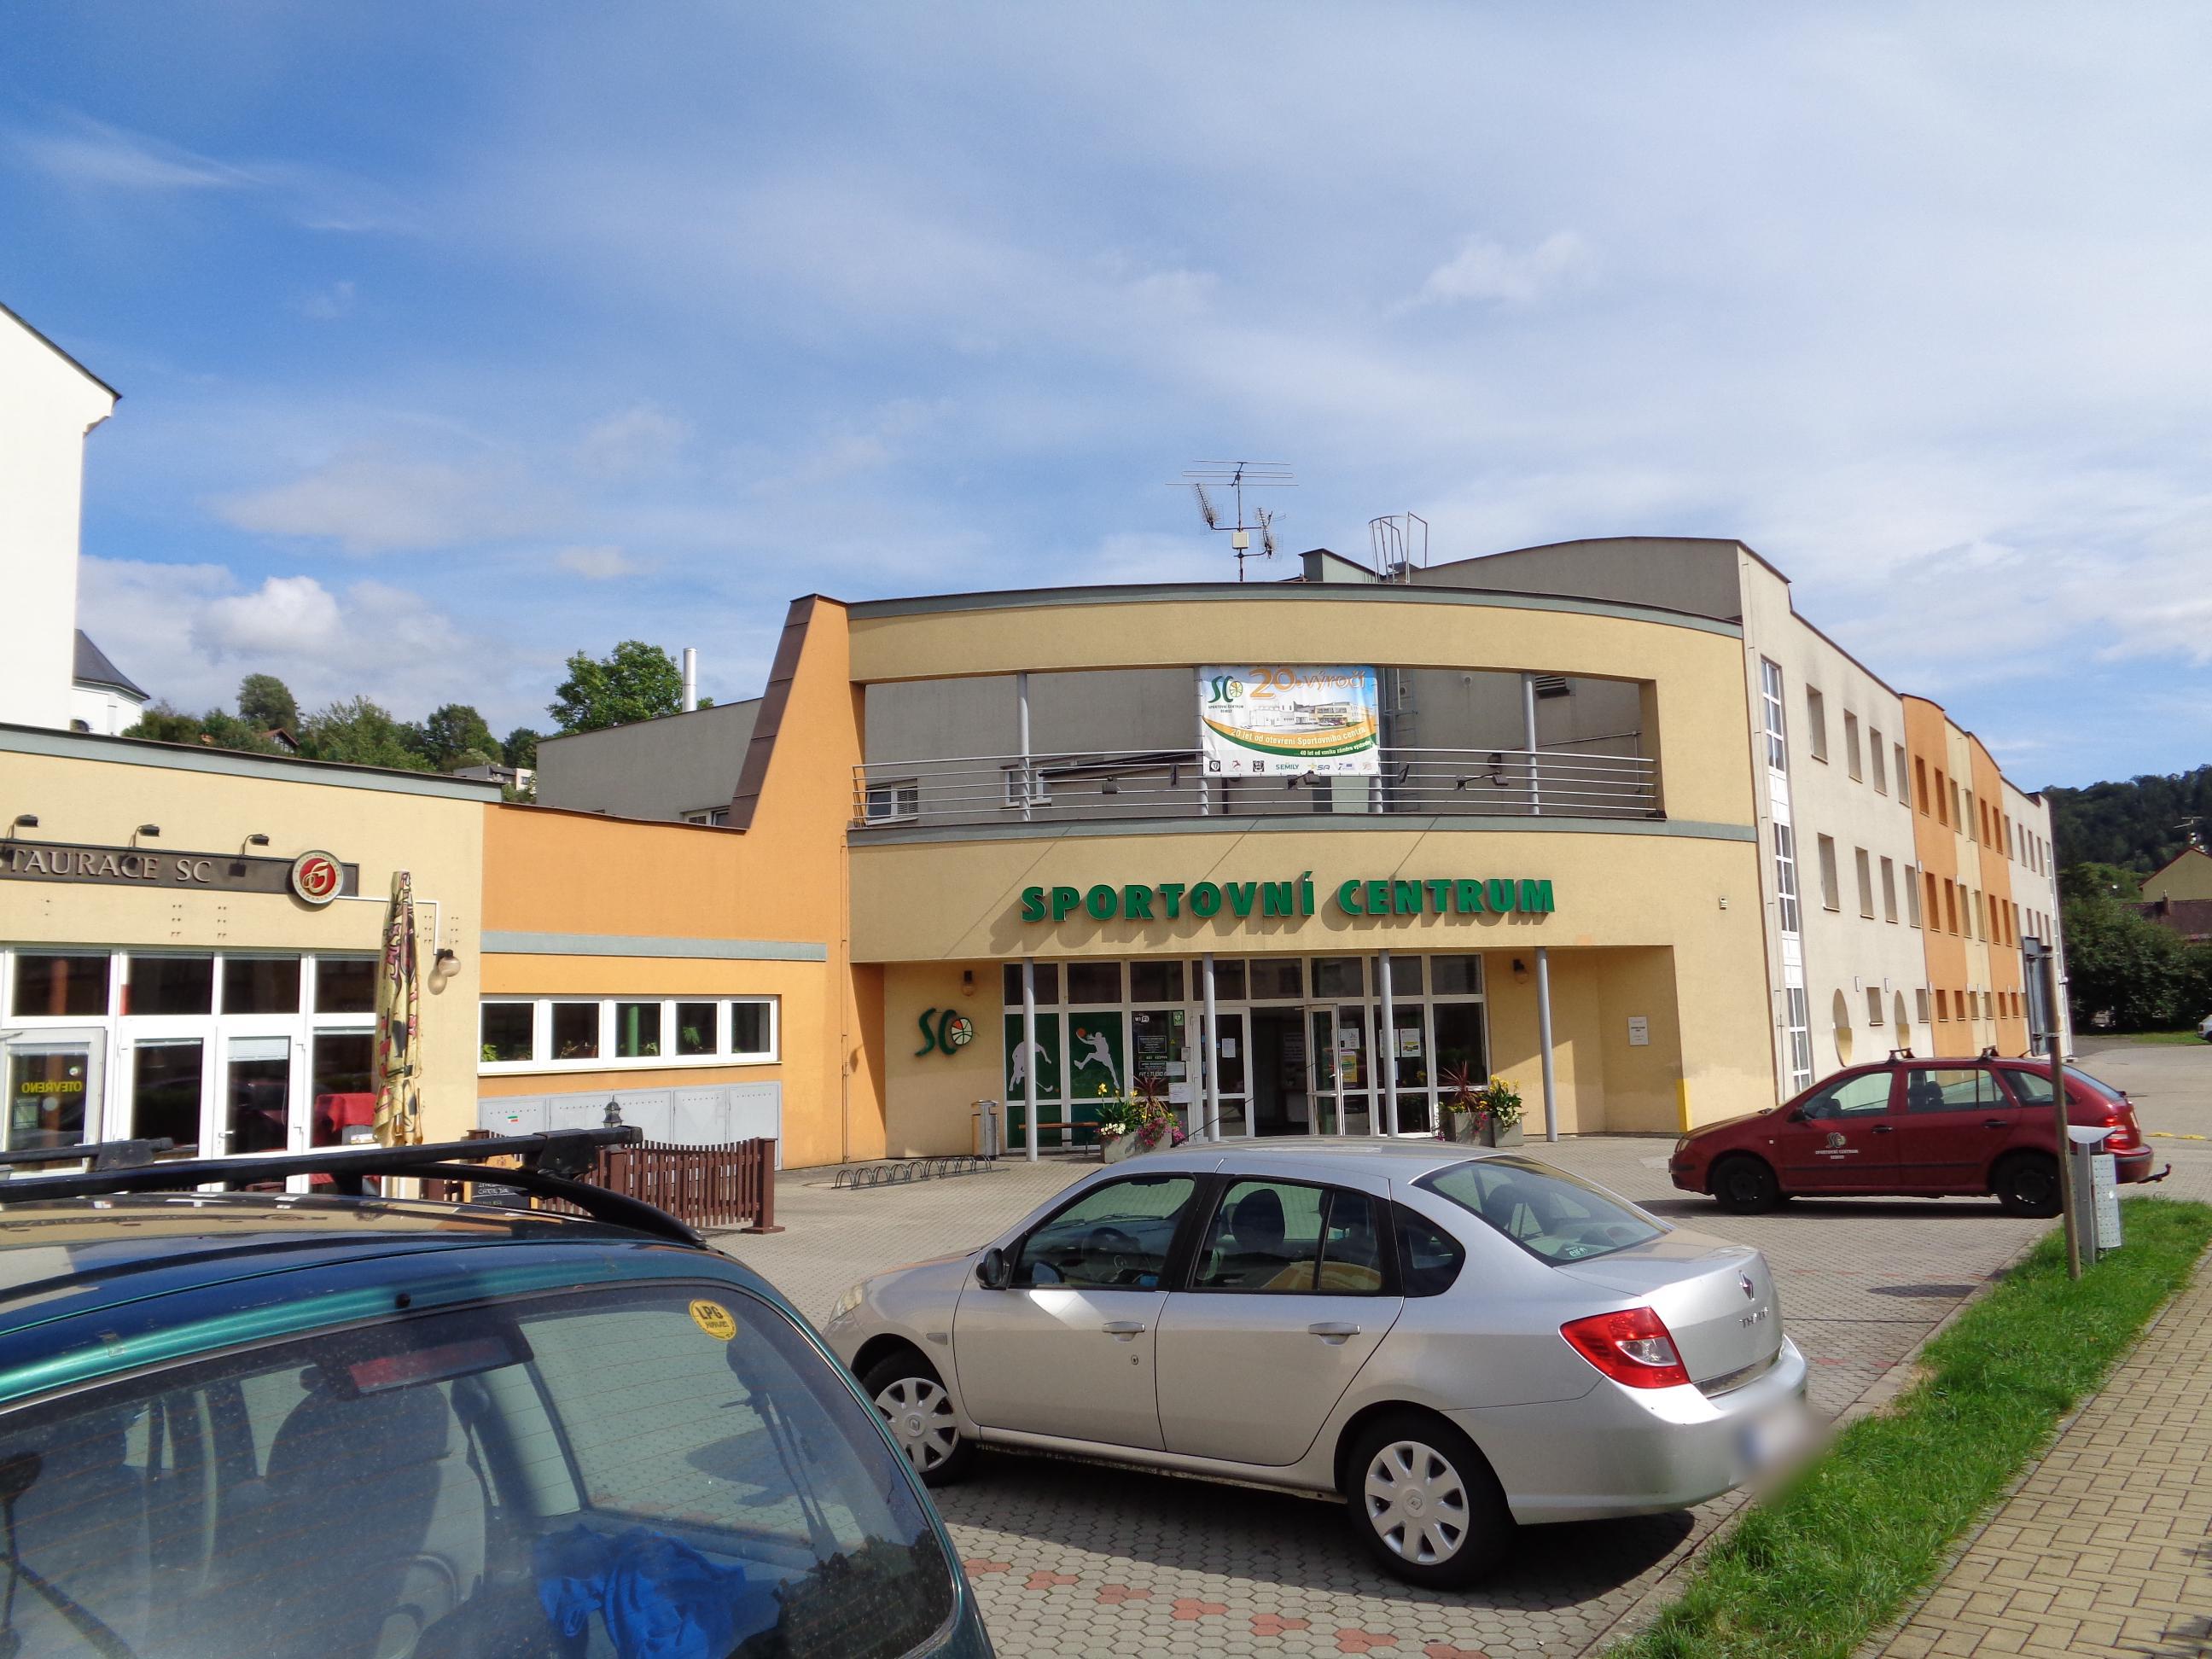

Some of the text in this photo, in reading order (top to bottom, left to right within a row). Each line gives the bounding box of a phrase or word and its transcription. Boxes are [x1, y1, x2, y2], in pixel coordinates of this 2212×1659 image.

[1231, 729, 1242, 737] 20
[1243, 731, 1253, 741] let
[1254, 734, 1264, 742] od
[1297, 734, 1342, 746] Sportovního
[0, 848, 212, 882] TAURACE SC
[1021, 871, 1556, 923] SPORTOVNÍ CENTRUM
[695, 1306, 724, 1320] LPG
